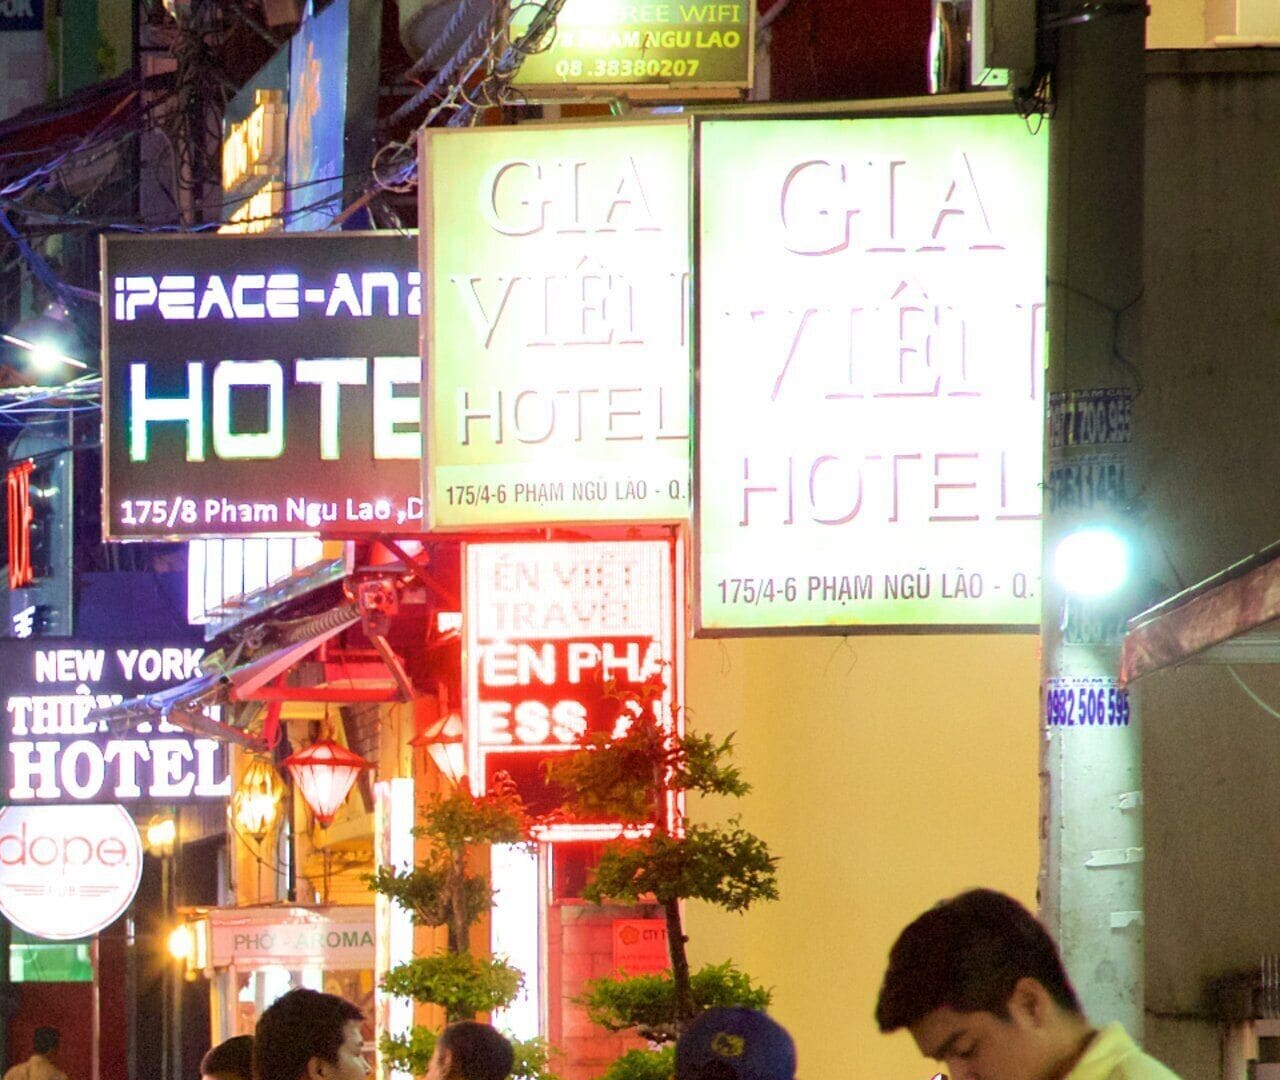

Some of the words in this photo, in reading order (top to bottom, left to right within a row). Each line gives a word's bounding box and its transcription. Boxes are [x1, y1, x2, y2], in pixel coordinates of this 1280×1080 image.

[612, 5, 670, 22] REE
[680, 5, 740, 23] WIFI
[646, 31, 691, 48] NGU
[696, 31, 740, 49] LAO
[480, 153, 662, 237] GIA
[770, 150, 1007, 256] GIA
[446, 484, 507, 506] 175/4-6
[514, 481, 564, 506] PHẠM
[120, 496, 197, 527] 175/8
[205, 498, 278, 522] Pham
[287, 497, 337, 527] Ngu
[346, 497, 391, 521] Lao
[717, 575, 798, 607] 175/4-6
[807, 574, 874, 606] PHẠM
[884, 566, 931, 601] NGŨ
[940, 566, 984, 600] LÃO
[35, 648, 105, 683] NEW
[117, 648, 206, 682] YORK
[1078, 688, 1105, 726] 506
[8, 739, 231, 800] HOTEL
[295, 930, 375, 948] AROMA
